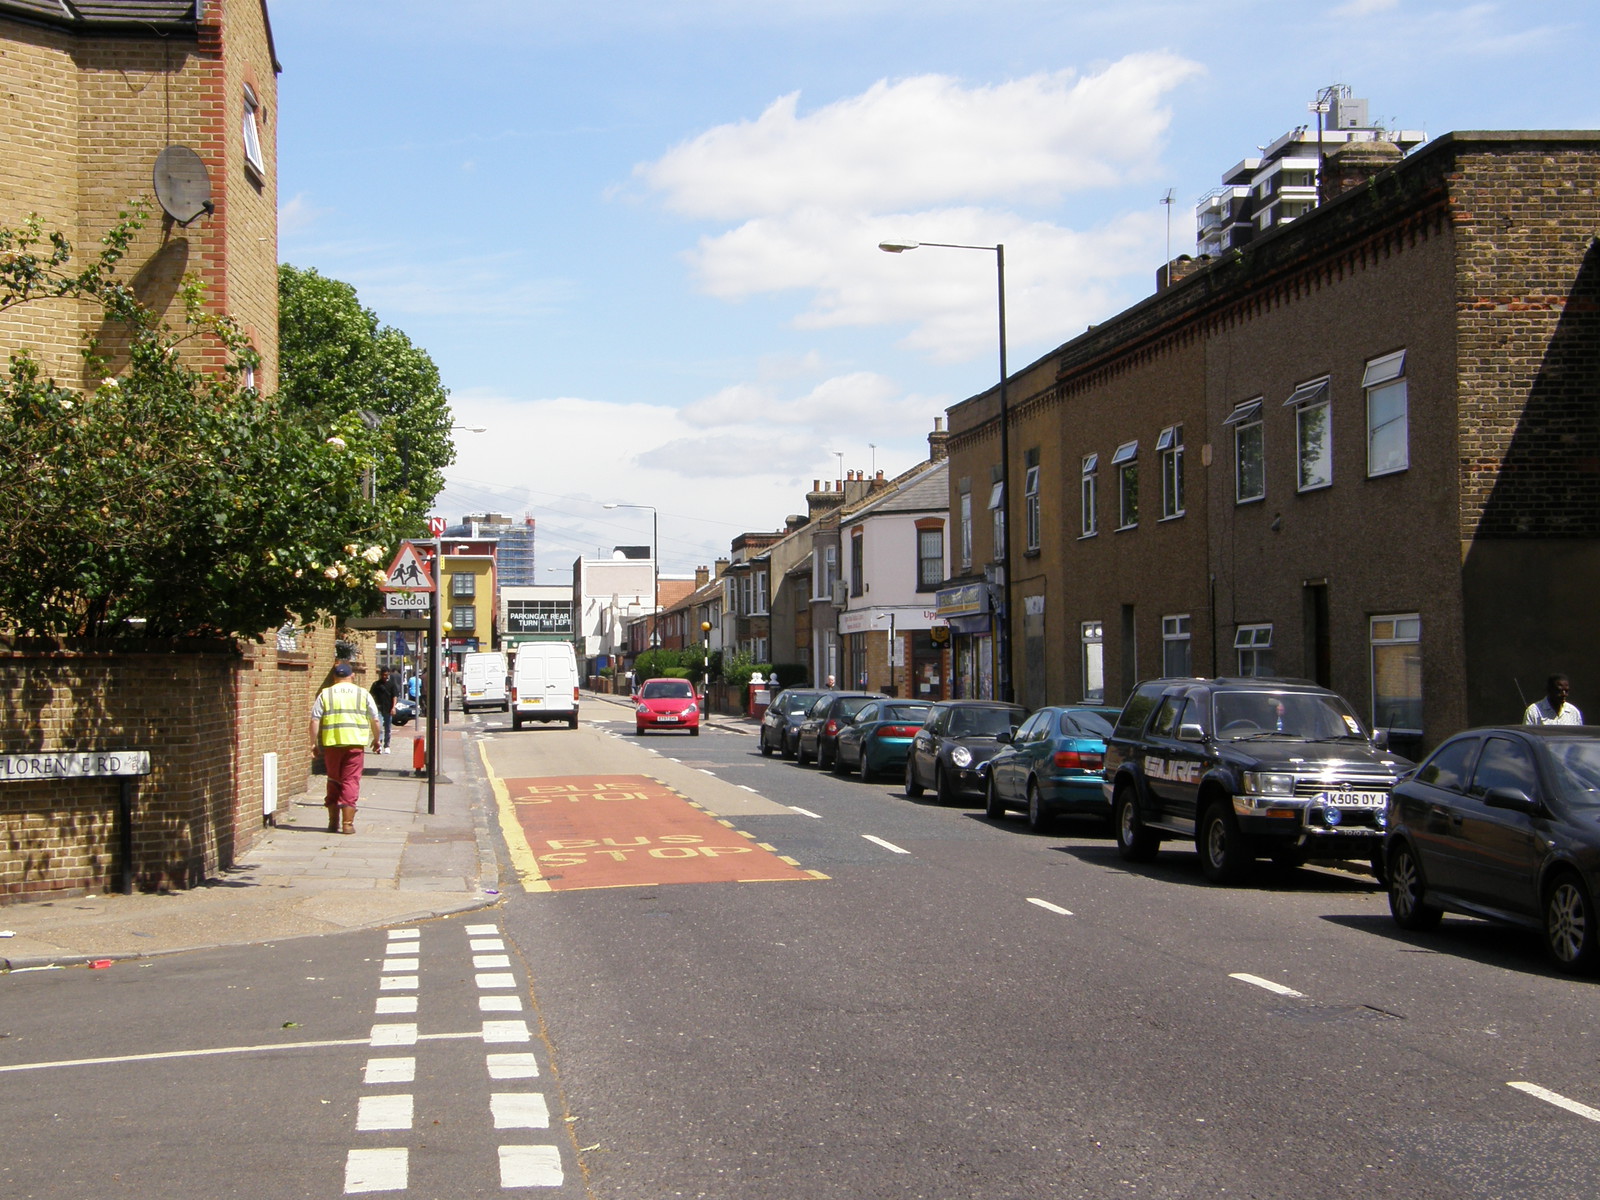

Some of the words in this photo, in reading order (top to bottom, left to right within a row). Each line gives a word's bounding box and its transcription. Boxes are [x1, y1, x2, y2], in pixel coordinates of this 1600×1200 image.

[431, 519, 444, 531] N
[390, 596, 427, 606] School
[0, 758, 90, 775] LORENE
[97, 756, 121, 772] RD
[1144, 756, 1201, 782] SURF
[528, 783, 643, 794] BUS
[512, 792, 667, 805] STOP
[1329, 793, 1359, 805] K506
[1362, 793, 1384, 805] OYJ
[546, 834, 704, 849] BUS
[537, 846, 753, 867] STOP
